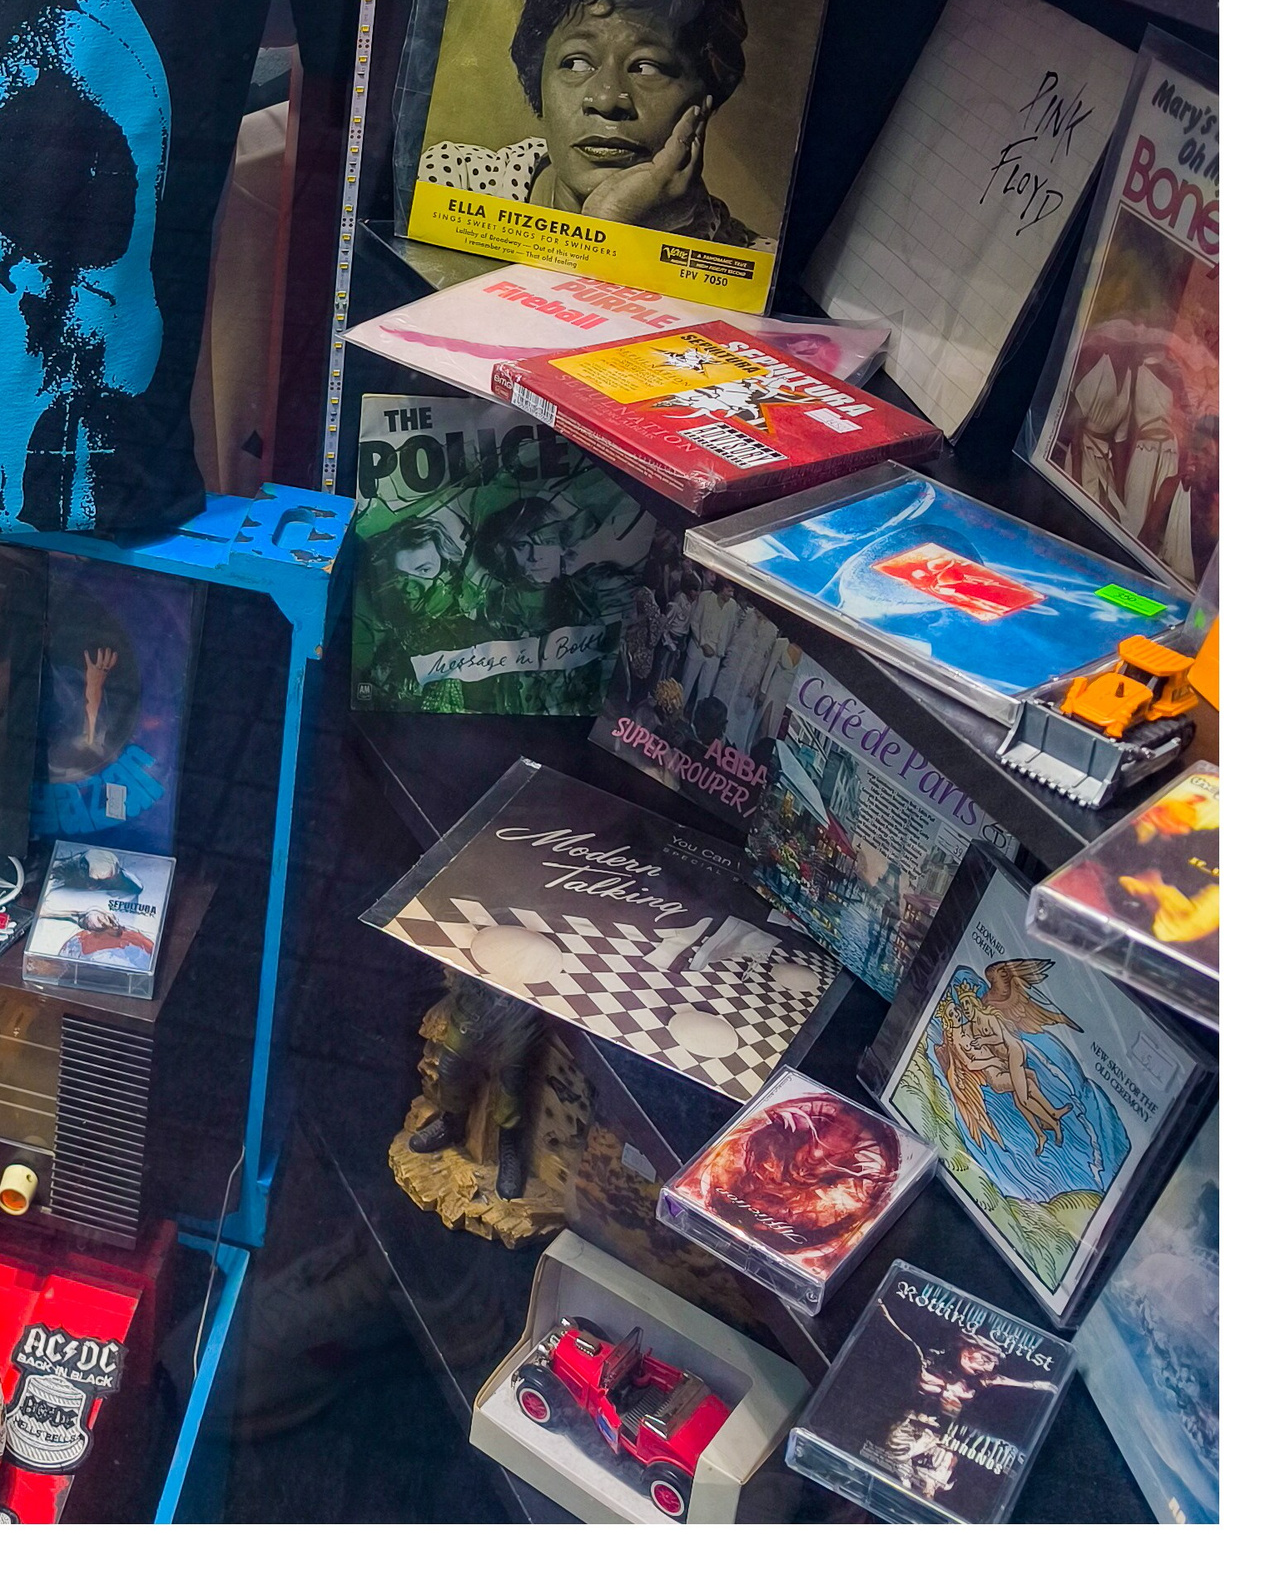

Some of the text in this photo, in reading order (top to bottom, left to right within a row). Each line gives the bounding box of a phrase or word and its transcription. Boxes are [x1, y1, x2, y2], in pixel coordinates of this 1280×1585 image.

[1018, 71, 1096, 164] PINK
[1151, 79, 1218, 135] Mary's
[1177, 137, 1206, 174] Oh
[980, 135, 1064, 237] FLOYD
[432, 211, 618, 257] SINGS SWEET SONGS FOR SWINGERS
[448, 199, 607, 244] ELLA FITZGERALD
[455, 226, 590, 262] Lullaby of Broadway Out of this world
[468, 239, 502, 252] remember
[502, 246, 515, 255] you
[525, 250, 540, 260] That
[541, 253, 553, 263] old
[554, 256, 578, 269] feeling
[680, 268, 728, 287] EPV 7050
[482, 280, 610, 331] Fireball
[551, 280, 681, 329] PURPLE
[680, 333, 762, 374] SEPULTURA
[720, 340, 875, 418] SEPULTURA
[383, 406, 433, 433] THE
[555, 373, 699, 453] SEPULNATION
[358, 424, 571, 500] POLICE
[694, 425, 775, 466] ADVISORY
[612, 716, 751, 810] SUPER TROUPER
[704, 737, 769, 789] ABBA
[798, 675, 979, 828] Café de Paris
[495, 827, 663, 878] Modern
[662, 847, 721, 875] SPECIAL
[672, 835, 732, 867] You Can
[108, 899, 157, 915] SEPULTURA
[542, 861, 689, 923] Talking
[971, 931, 996, 959] COHEN
[975, 921, 1006, 956] LEONARD
[1090, 1041, 1159, 1115] NEW SKIN FOR THE
[1094, 1061, 1153, 1123] OLD CEREMONY
[895, 1280, 1056, 1372] Rotting Christ
[16, 1352, 114, 1388] BACK IN BLACK
[23, 1327, 120, 1374] AC/DC
